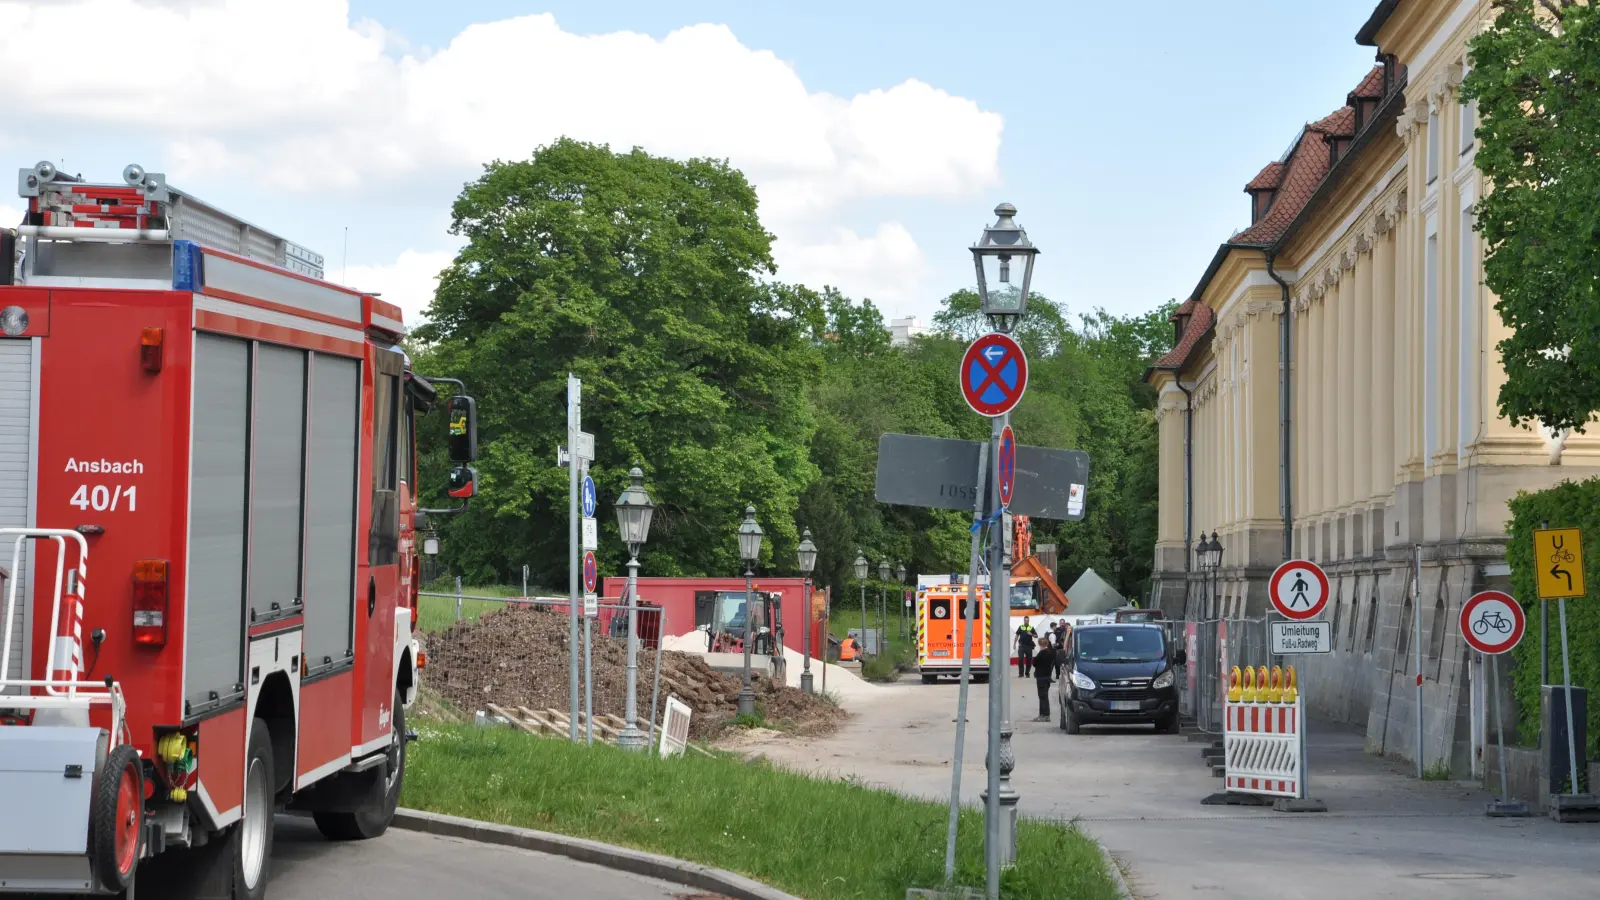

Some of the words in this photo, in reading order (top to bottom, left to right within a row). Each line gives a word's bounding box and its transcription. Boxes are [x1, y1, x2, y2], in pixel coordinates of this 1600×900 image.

[64, 457, 144, 474] Ansbach
[69, 484, 137, 512] 40/1
[1552, 534, 1564, 549] U
[1281, 625, 1320, 638] Umleitung
